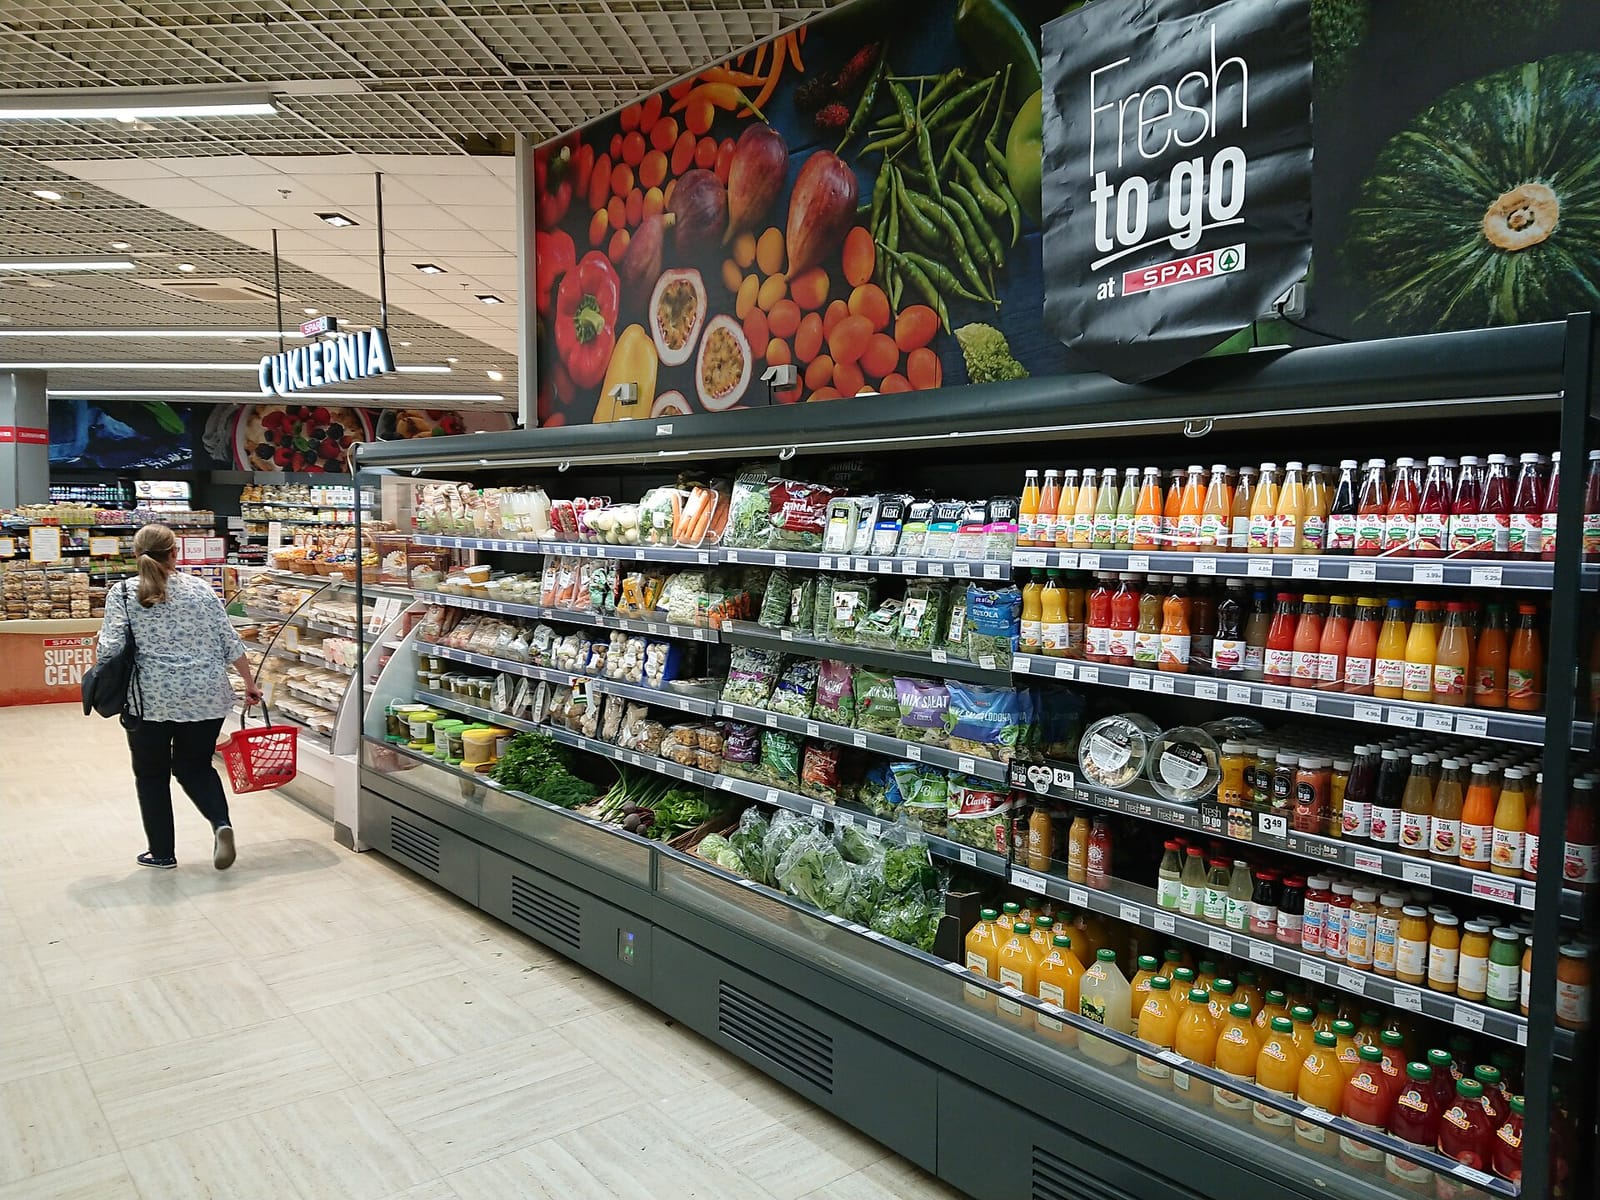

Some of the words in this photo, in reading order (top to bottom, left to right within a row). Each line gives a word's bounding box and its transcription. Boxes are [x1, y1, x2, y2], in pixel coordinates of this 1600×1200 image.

[1089, 23, 1247, 176] Fresh
[1090, 170, 1148, 252] to
[1167, 146, 1246, 250] go
[1096, 276, 1115, 299] at
[1143, 251, 1213, 287] SPAR
[304, 320, 321, 334] SPAR
[259, 327, 389, 397] CUKIERNIA
[44, 648, 93, 666] SUPER
[901, 693, 919, 707] MIX
[921, 695, 950, 709] SAŁAT
[965, 793, 991, 807] Classic
[1201, 803, 1221, 818] Fresh
[1202, 814, 1210, 824] to
[1211, 818, 1221, 828] go
[1406, 817, 1418, 826] SOK
[1438, 822, 1451, 831] SOK
[1496, 833, 1509, 842] SOK
[1304, 841, 1323, 856] Fresh
[1352, 1078, 1378, 1093] ANDROS
[1400, 1095, 1427, 1111] ANDROS
